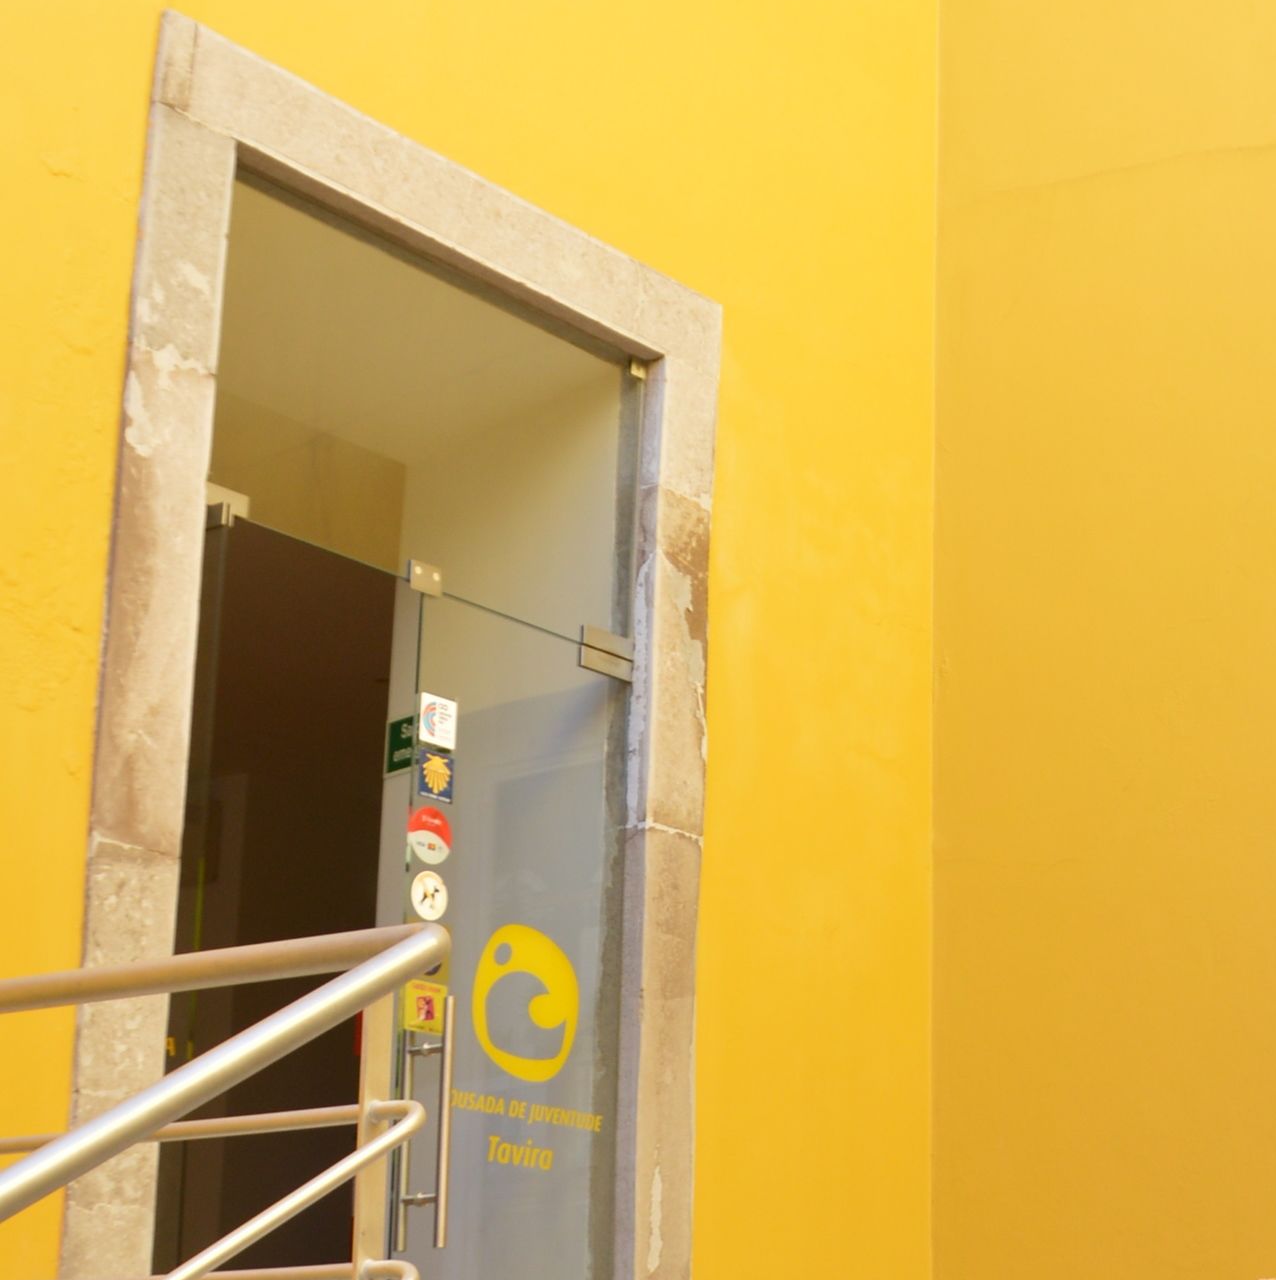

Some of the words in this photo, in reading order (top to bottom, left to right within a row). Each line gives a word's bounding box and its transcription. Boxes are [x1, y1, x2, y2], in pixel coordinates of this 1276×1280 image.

[508, 1099, 527, 1119] DE
[527, 1103, 604, 1132] JUVENTUDE
[487, 1135, 554, 1170] Tavira
